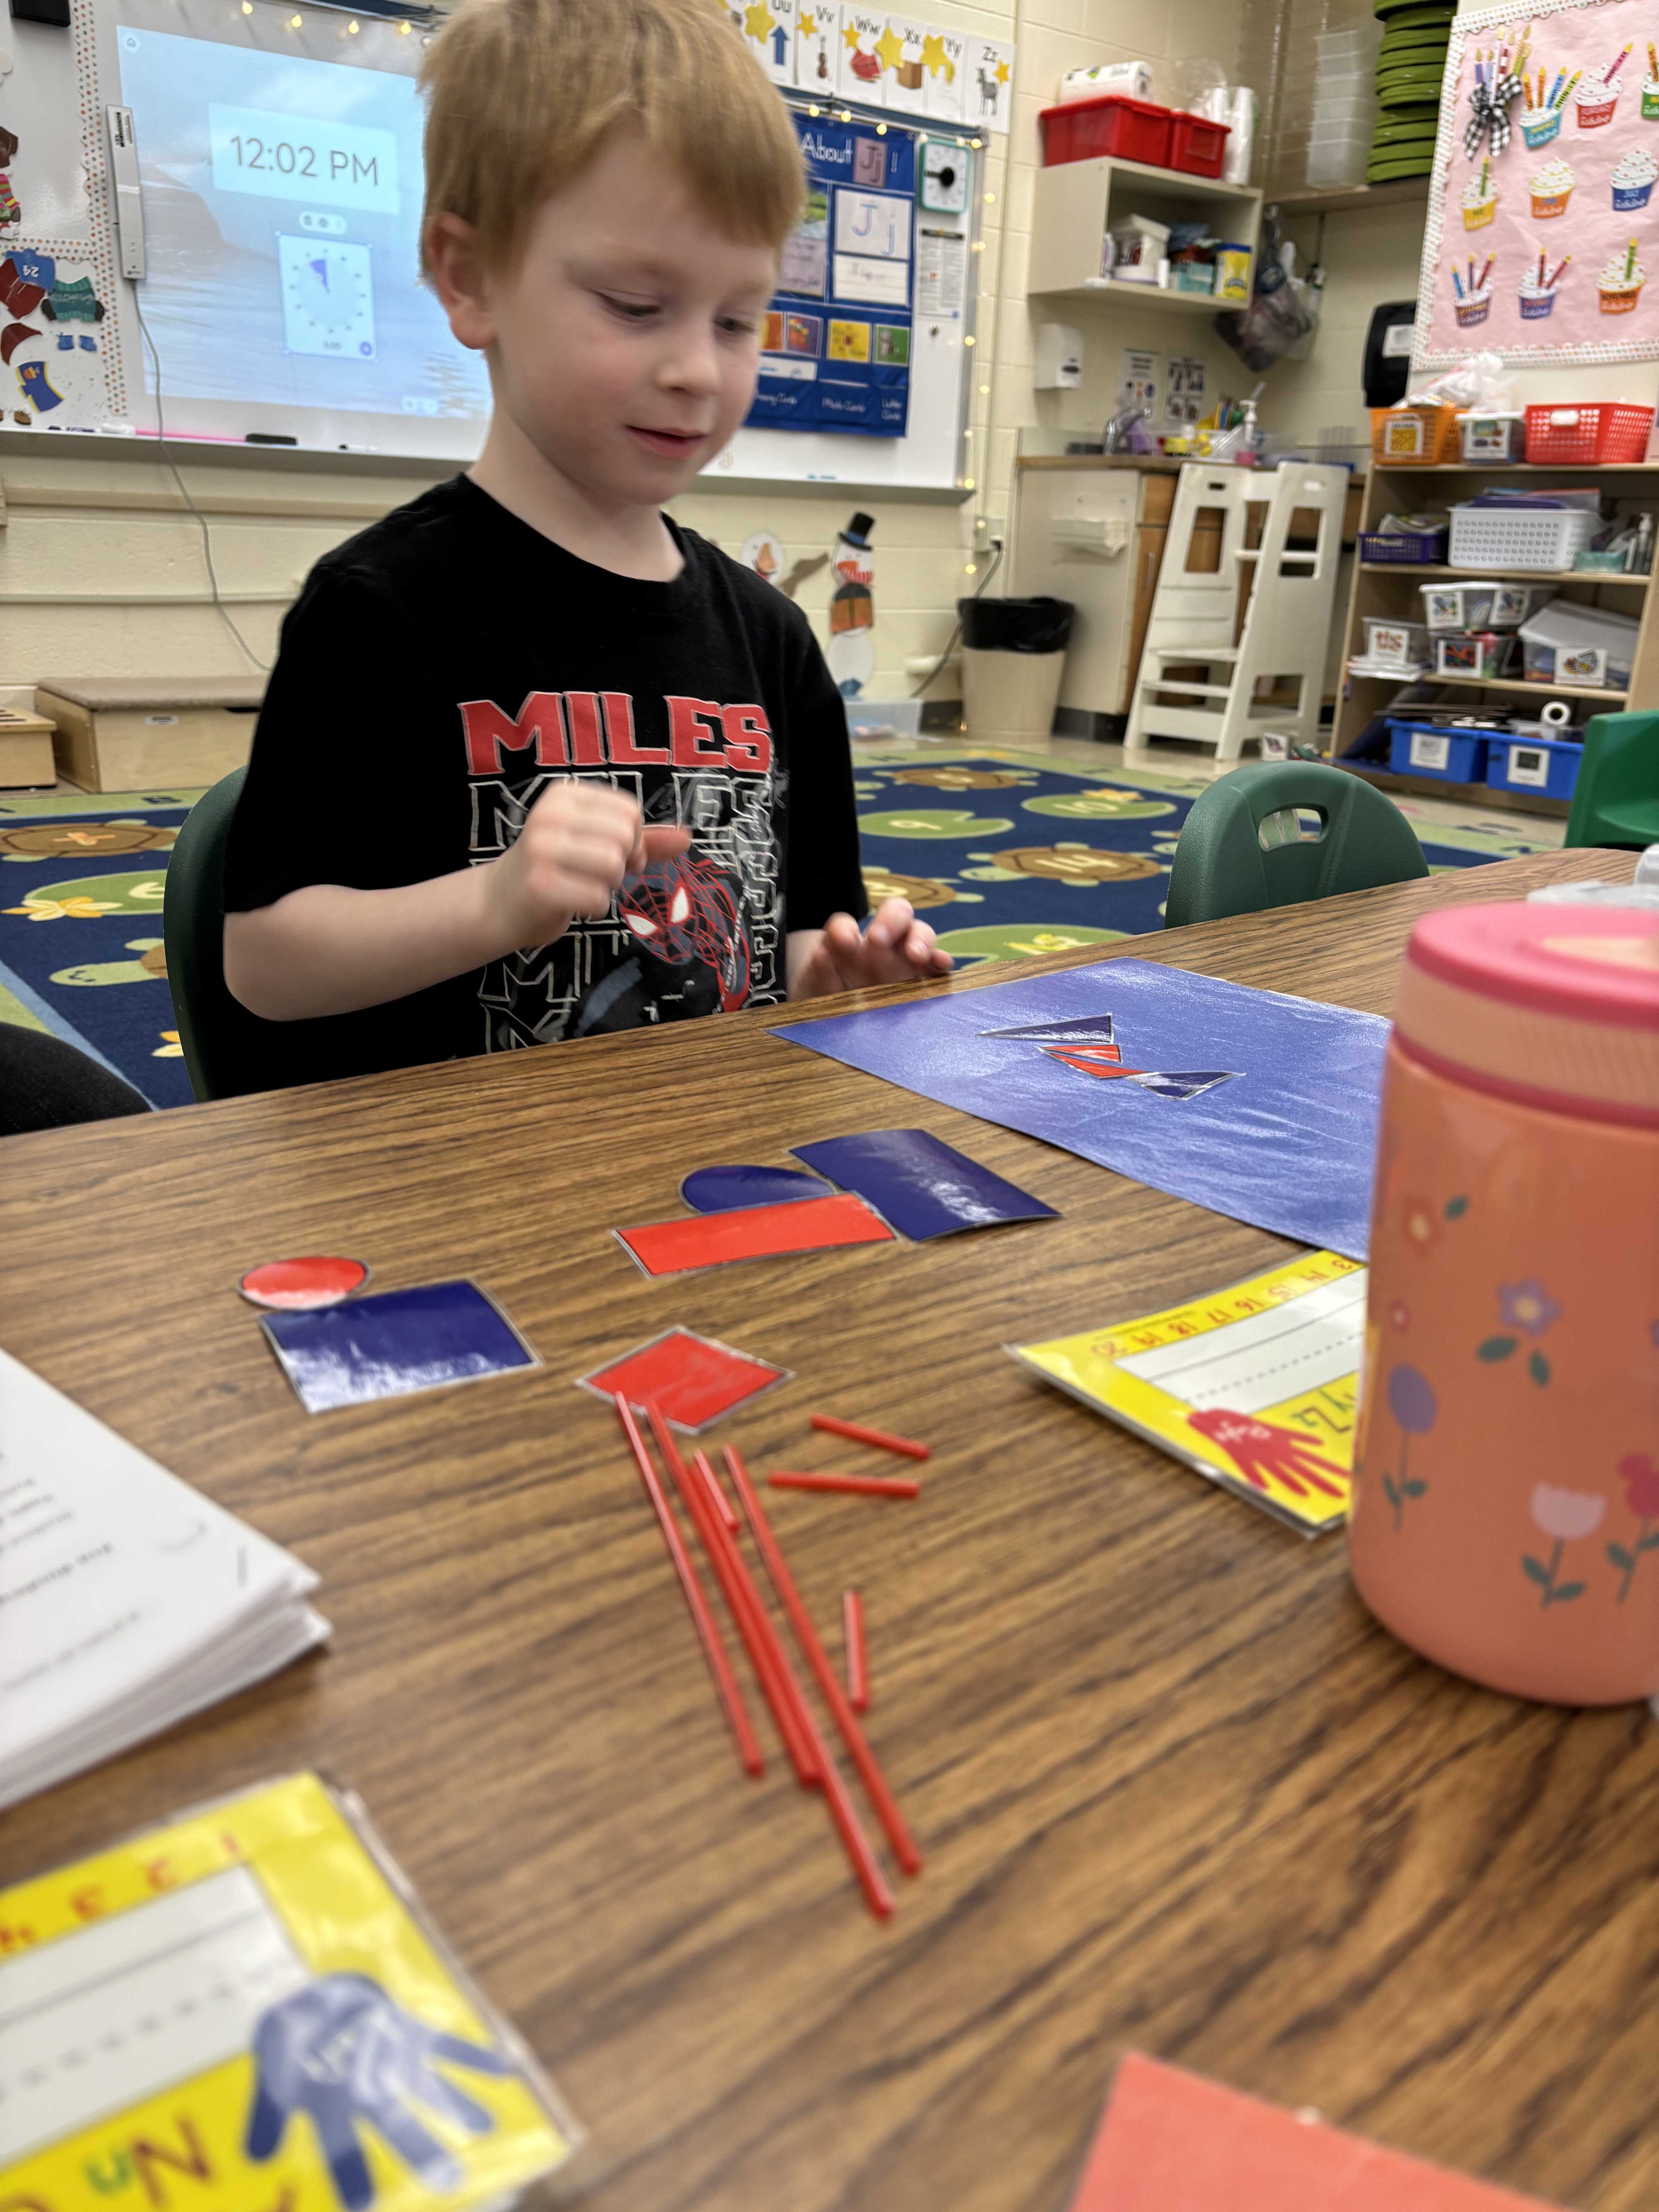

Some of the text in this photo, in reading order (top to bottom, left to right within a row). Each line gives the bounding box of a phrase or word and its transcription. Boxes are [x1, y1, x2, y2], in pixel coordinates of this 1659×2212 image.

[816, 4, 835, 23] Vv
[904, 27, 922, 45] Xx
[945, 37, 963, 58] Yy
[982, 46, 998, 62] Zz
[800, 132, 853, 165] About
[231, 136, 378, 186] 12:02 PM
[457, 690, 773, 775] MILES
[1034, 853, 1120, 874] 14
[1300, 1270, 1330, 1283] 14
[1234, 1297, 1265, 1312] 16
[1167, 1320, 1199, 1335] 18
